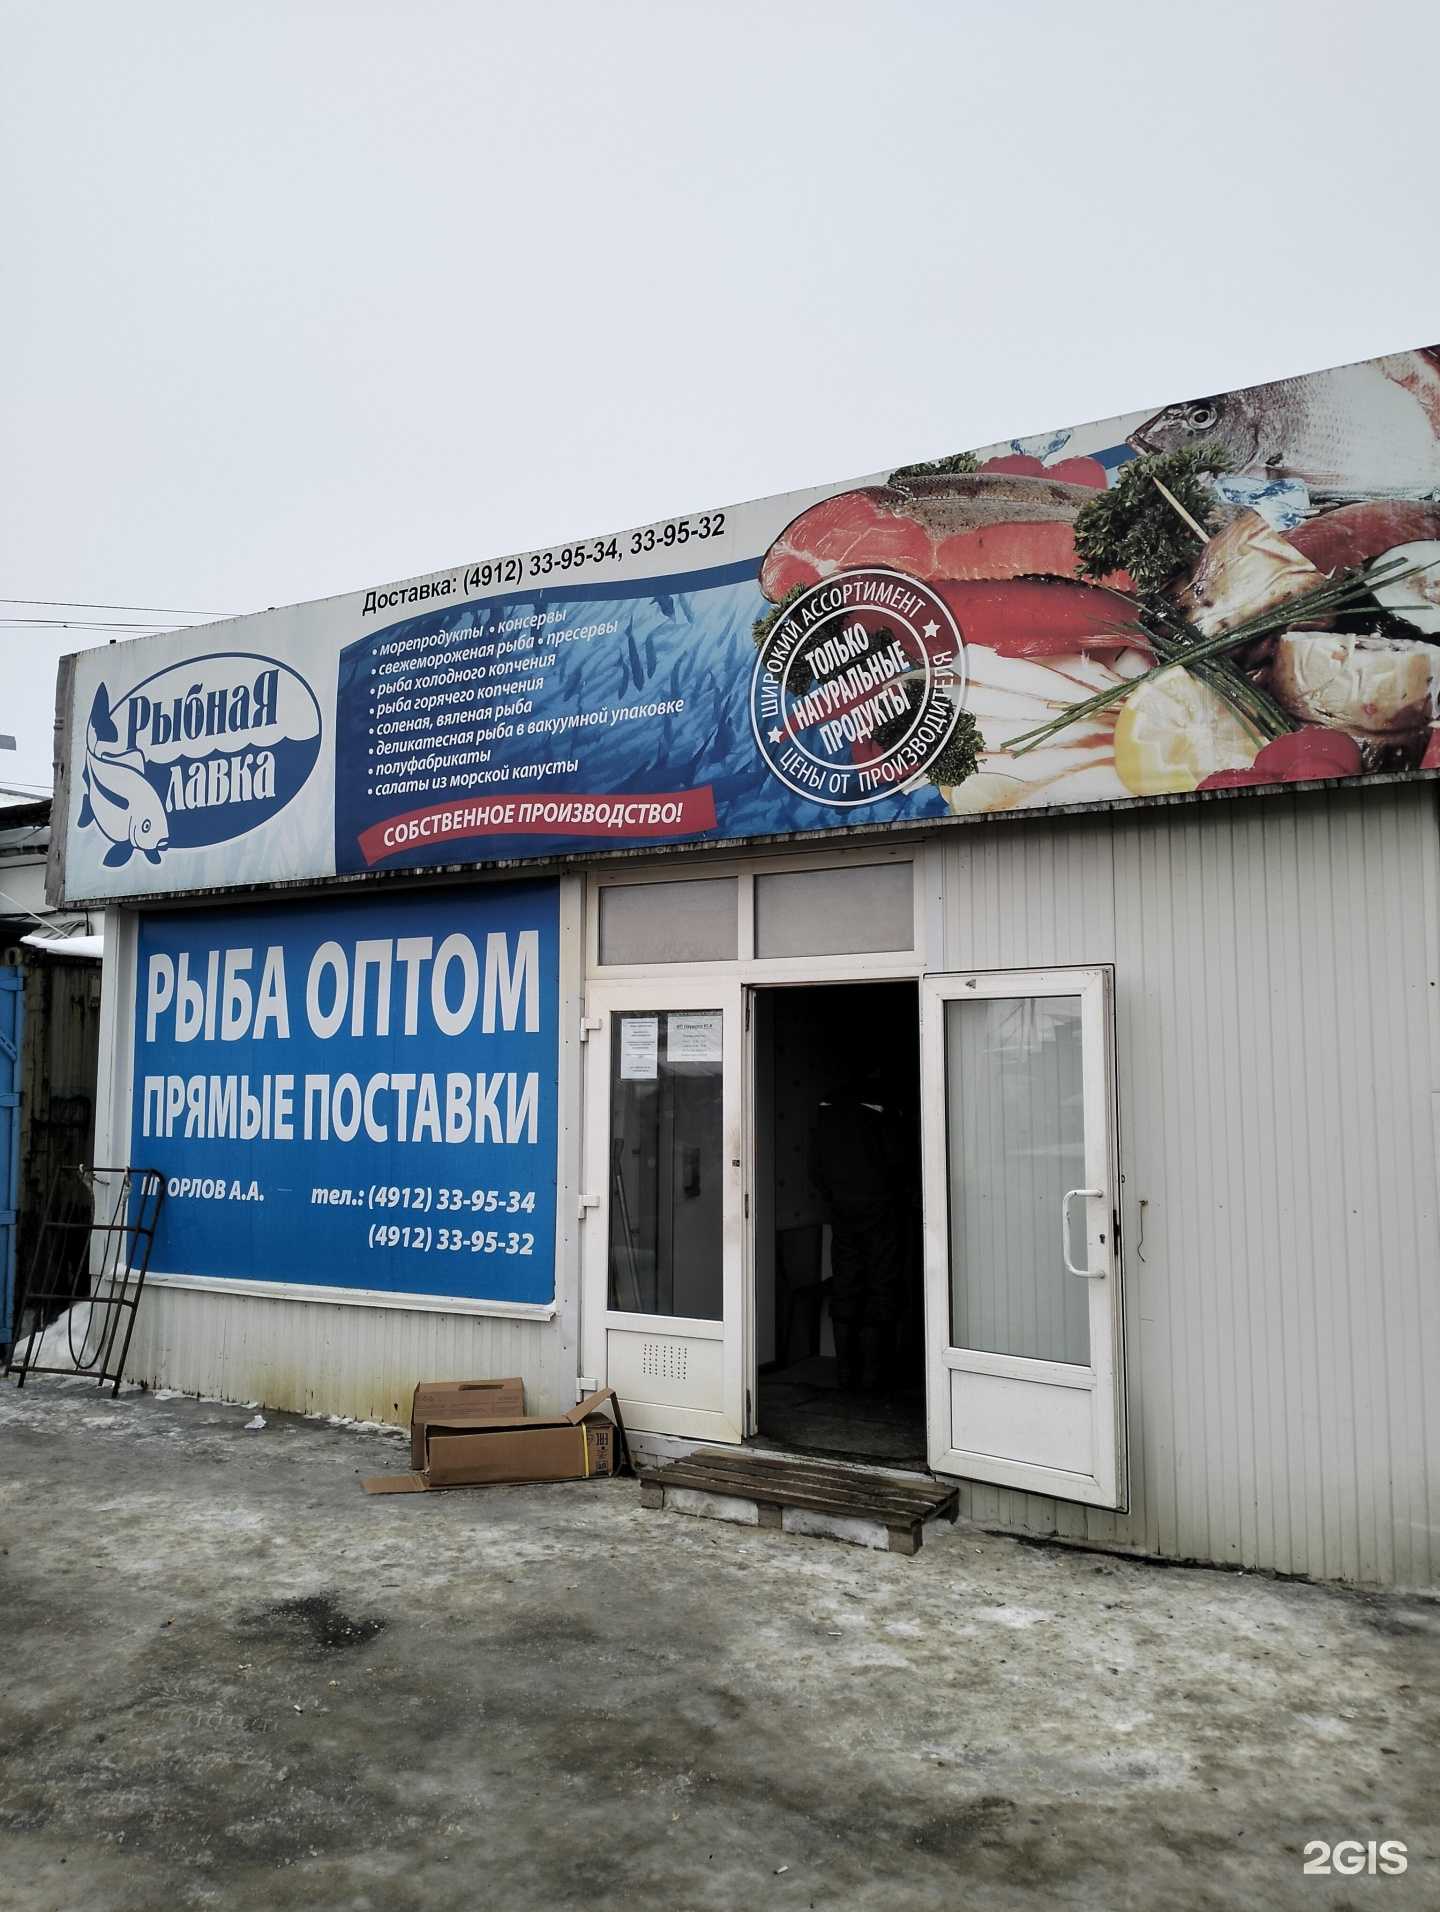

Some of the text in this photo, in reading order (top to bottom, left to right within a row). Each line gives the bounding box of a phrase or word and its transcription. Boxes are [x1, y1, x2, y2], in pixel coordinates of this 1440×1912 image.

[363, 513, 726, 616] Доставка: (4912) 33-95-34, 33-95-32
[378, 620, 619, 676] свежемороженая рыба пресервы
[379, 609, 567, 657] морепродукты консервы
[762, 581, 927, 719] ШИРОКИЙ АССОРТИМЕНТ
[805, 622, 870, 680] ТОЛЬКО
[376, 653, 556, 699] рыба холодного копчения
[376, 677, 544, 719] рыба горячего копчения
[792, 639, 911, 731] НАТУРАЛЬНЫЕ
[376, 698, 533, 736] соленая, вяленая рыба
[376, 698, 685, 756] деликатесная рыба в вакуумной упаковке
[779, 650, 954, 794] ЦЕНЫ ОТ ПРОИЗВОДИТЕЛЯ
[819, 682, 912, 755] ПРОДУКТЫ
[375, 750, 491, 777] полуфабрикаты
[375, 759, 579, 796] салаты из морской капусты
[383, 803, 684, 847] СОБСТВЕННОЕ ПРОИЗВОДСТВО!
[146, 929, 541, 1044] РЫБА ОПТОМ
[142, 1071, 540, 1145] ПРЯМЫЕ ПОСТАВКИ
[167, 1177, 227, 1200] ОРЛОВ
[228, 1180, 265, 1202] А.А.
[311, 1185, 536, 1214] тел.: (4912) 33-95-34
[368, 1224, 535, 1256] (4912) 33-95-32
